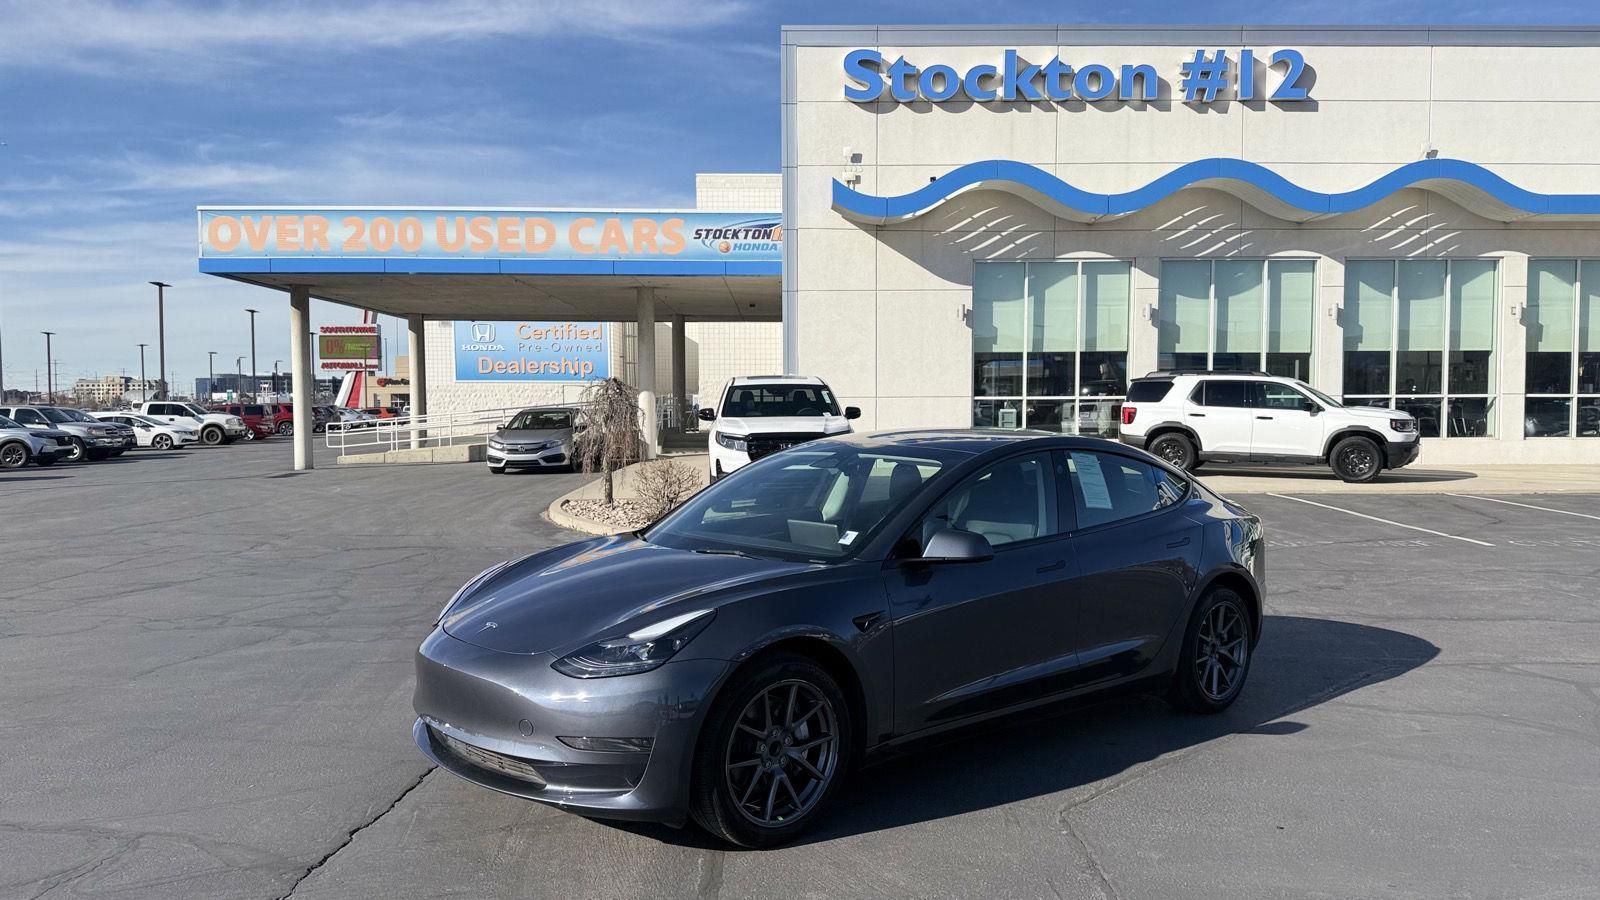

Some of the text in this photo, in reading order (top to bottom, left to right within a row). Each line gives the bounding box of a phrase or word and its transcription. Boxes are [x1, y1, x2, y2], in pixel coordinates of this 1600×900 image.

[843, 48, 1309, 103] Stockton #12
[207, 215, 687, 255] OVER 200 USED CARS
[693, 228, 773, 240] STOCKTON
[733, 242, 778, 251] HONDA
[516, 322, 603, 340] Certified
[517, 342, 603, 353] Pre-Owned
[477, 356, 594, 378] Dealership
